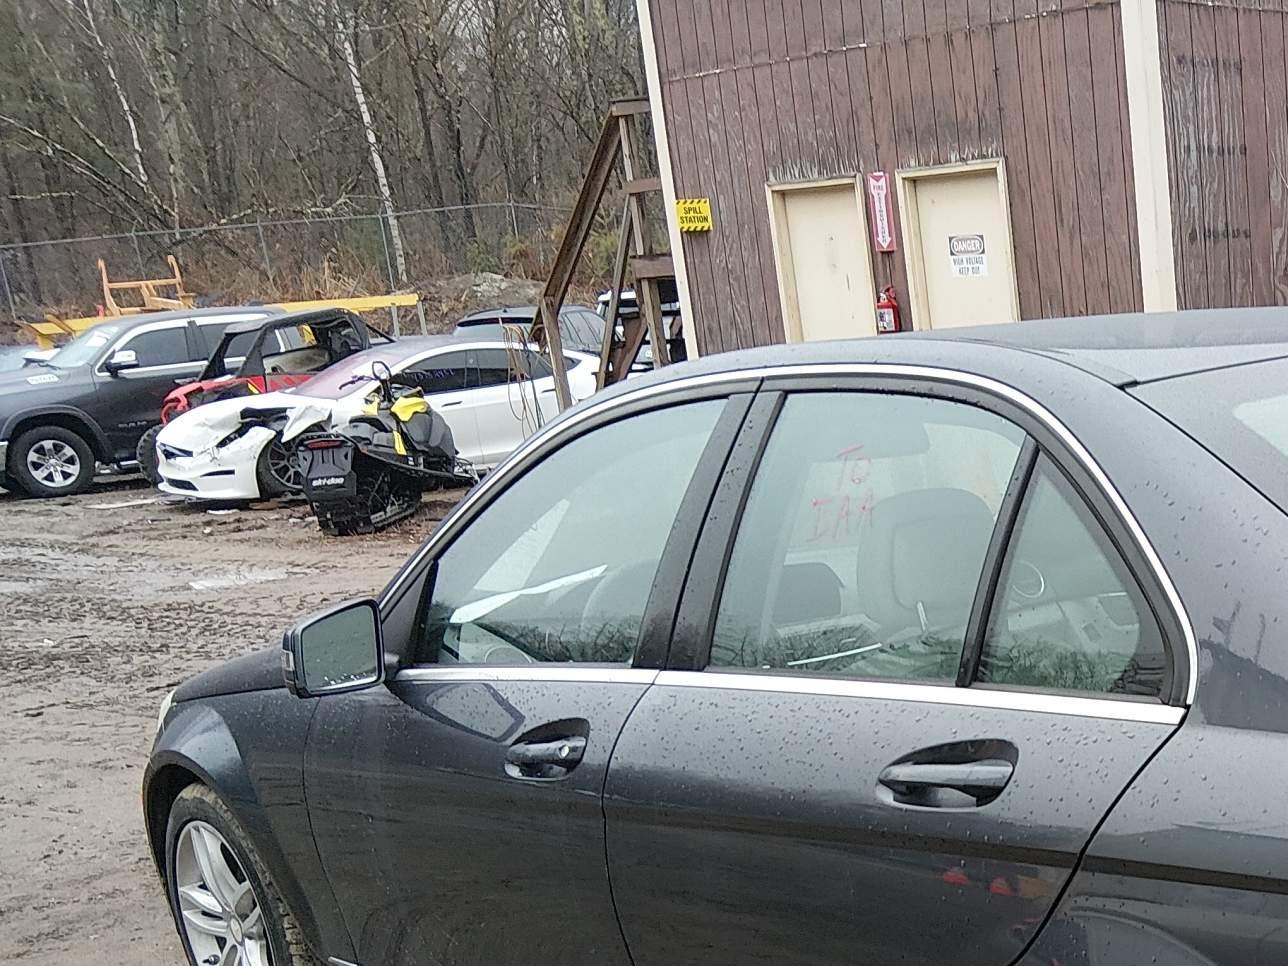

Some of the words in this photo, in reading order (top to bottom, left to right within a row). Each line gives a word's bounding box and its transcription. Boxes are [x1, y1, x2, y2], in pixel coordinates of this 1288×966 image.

[683, 206, 703, 215] SPILL
[680, 215, 709, 225] STATION
[953, 239, 981, 252] DANGER
